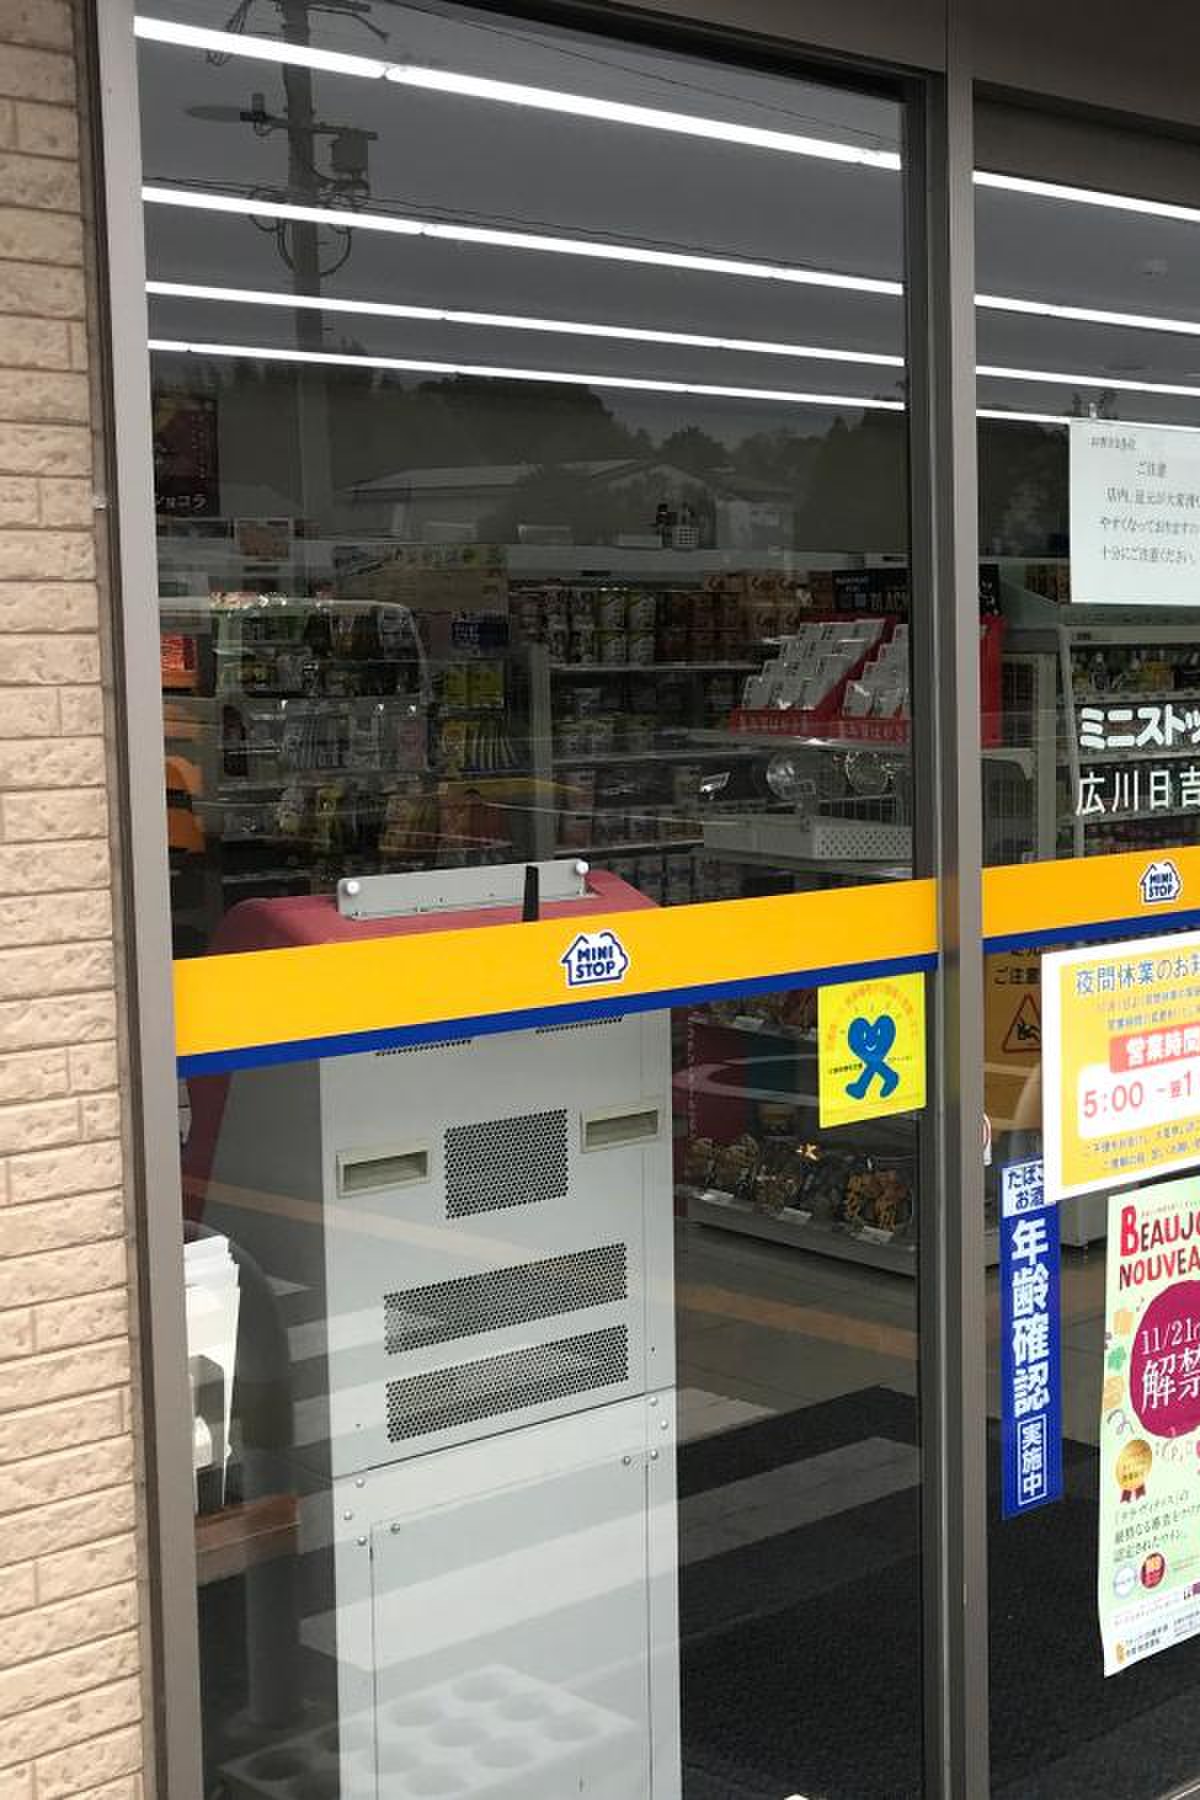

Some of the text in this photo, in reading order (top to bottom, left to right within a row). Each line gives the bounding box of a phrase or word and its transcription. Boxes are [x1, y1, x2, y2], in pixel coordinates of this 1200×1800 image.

[1149, 884, 1174, 898] STOP
[577, 945, 613, 962] MINI
[576, 960, 615, 978] STOP
[1126, 1026, 1200, 1069] 営業時間
[1011, 1216, 1051, 1418] 年齢確認
[1020, 1421, 1043, 1498] 実施中
